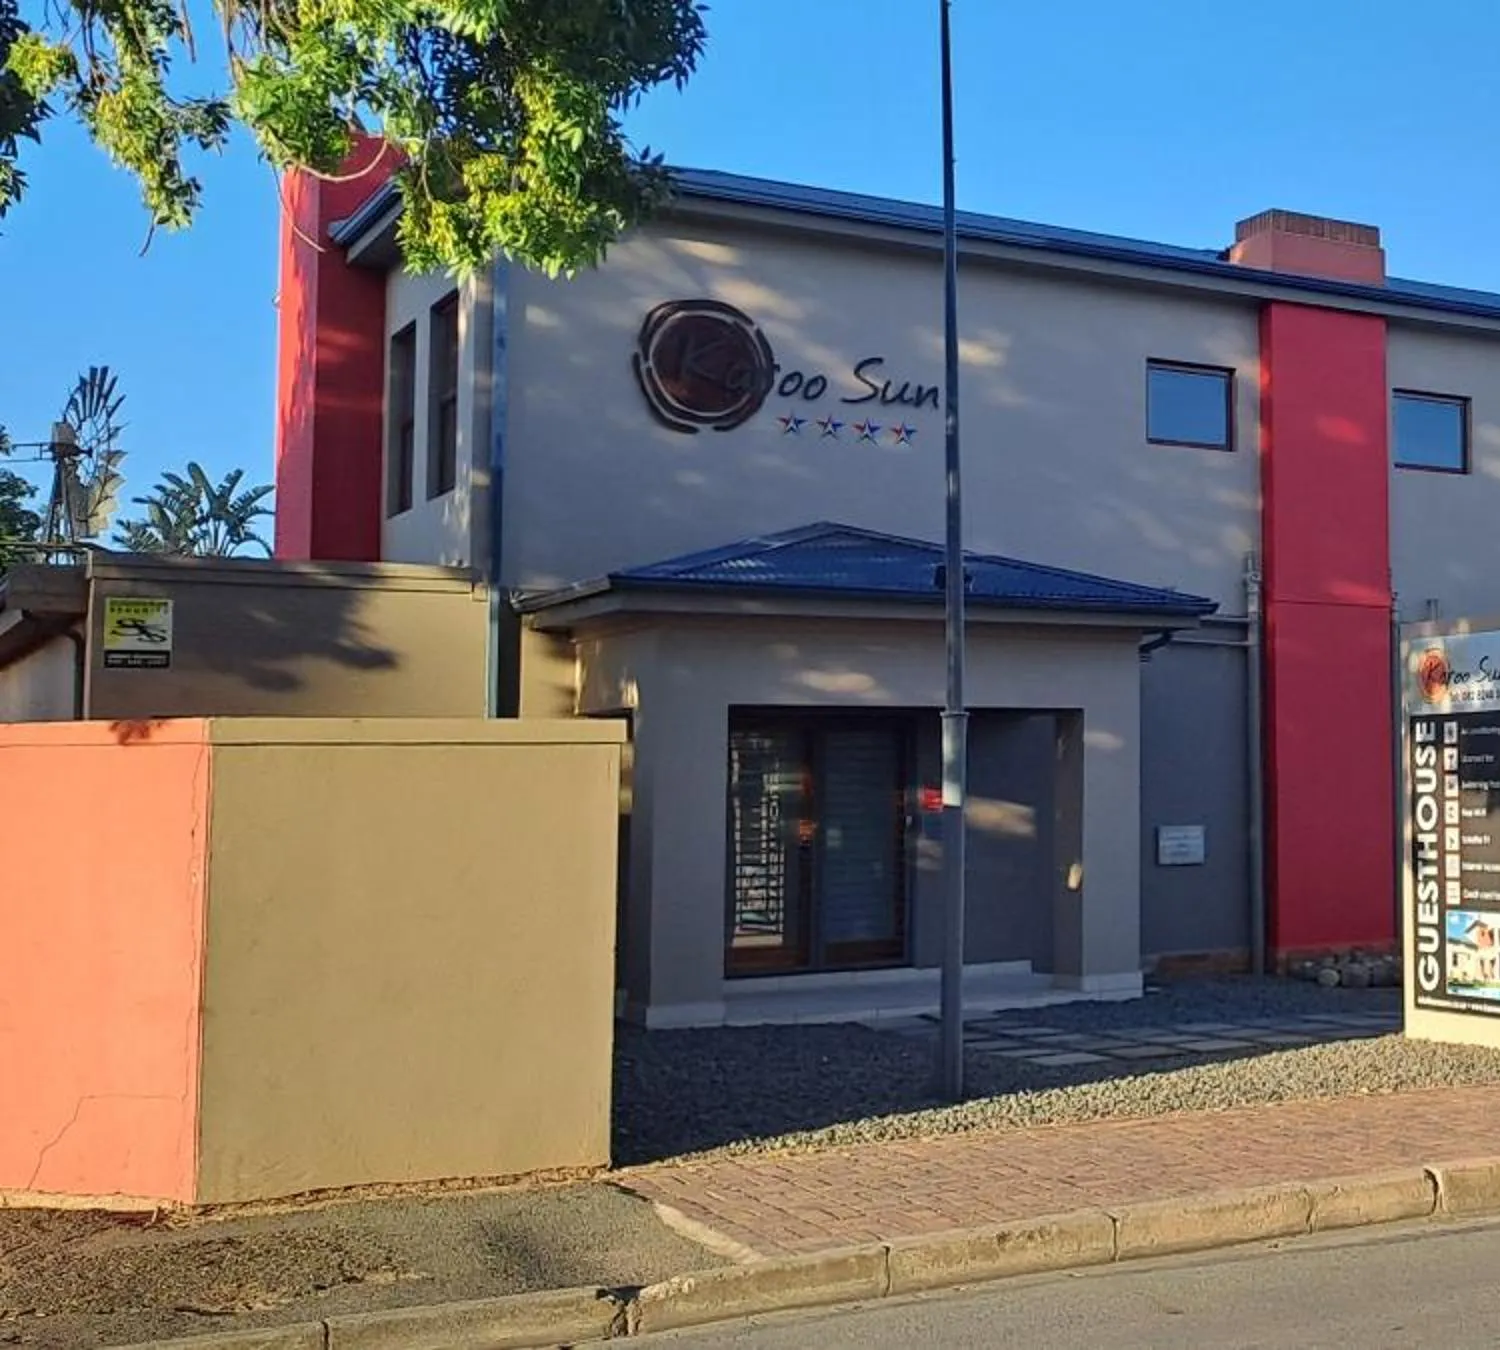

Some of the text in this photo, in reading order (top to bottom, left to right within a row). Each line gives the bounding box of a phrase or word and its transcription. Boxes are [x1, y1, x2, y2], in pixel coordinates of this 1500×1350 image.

[840, 357, 939, 409] Sun
[1424, 660, 1471, 687] Karoo
[1415, 721, 1440, 991] GUESTHOUSE
